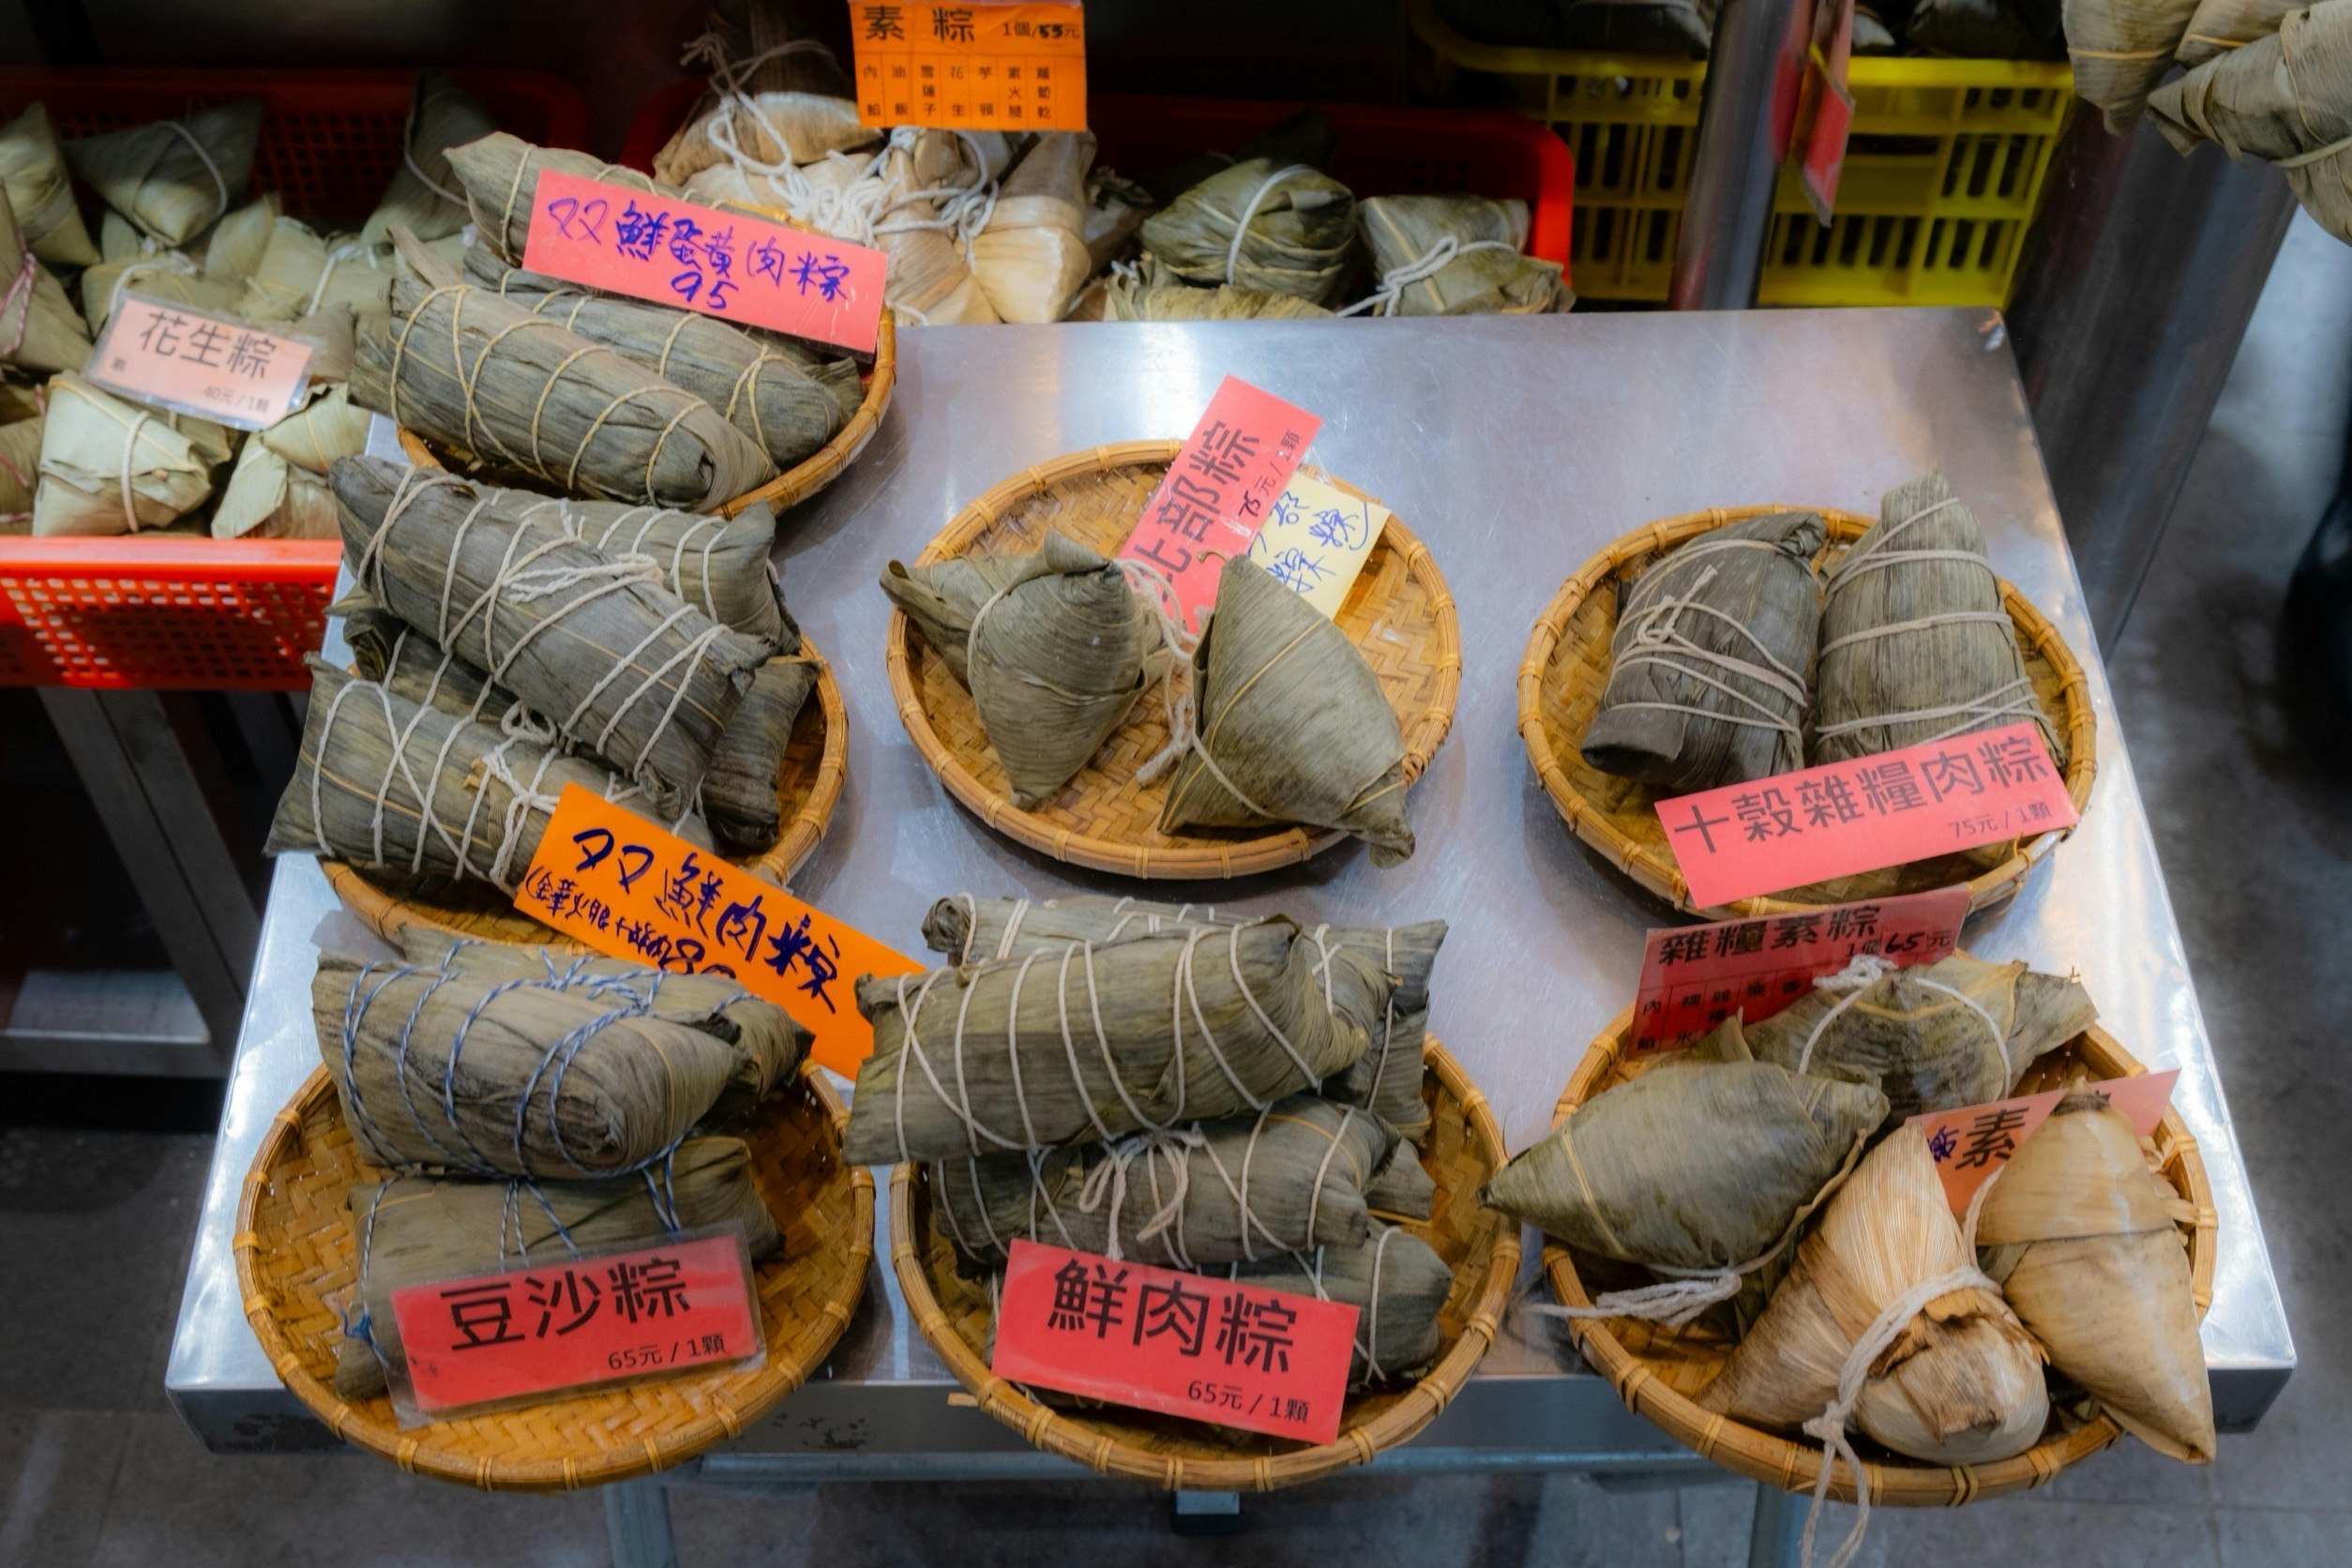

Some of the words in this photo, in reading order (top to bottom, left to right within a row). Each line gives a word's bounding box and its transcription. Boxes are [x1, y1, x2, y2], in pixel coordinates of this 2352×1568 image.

[862, 6, 975, 42] 素粽
[949, 66, 965, 117] 花生
[670, 270, 739, 310] 95
[140, 311, 277, 380] 花生粽
[1674, 736, 2050, 853] 十穀雜糧肉粽
[1658, 905, 1881, 966] 雜糧素粽
[440, 1257, 691, 1352] 豆沙粽
[1047, 1258, 1298, 1373] 鮮肉粽
